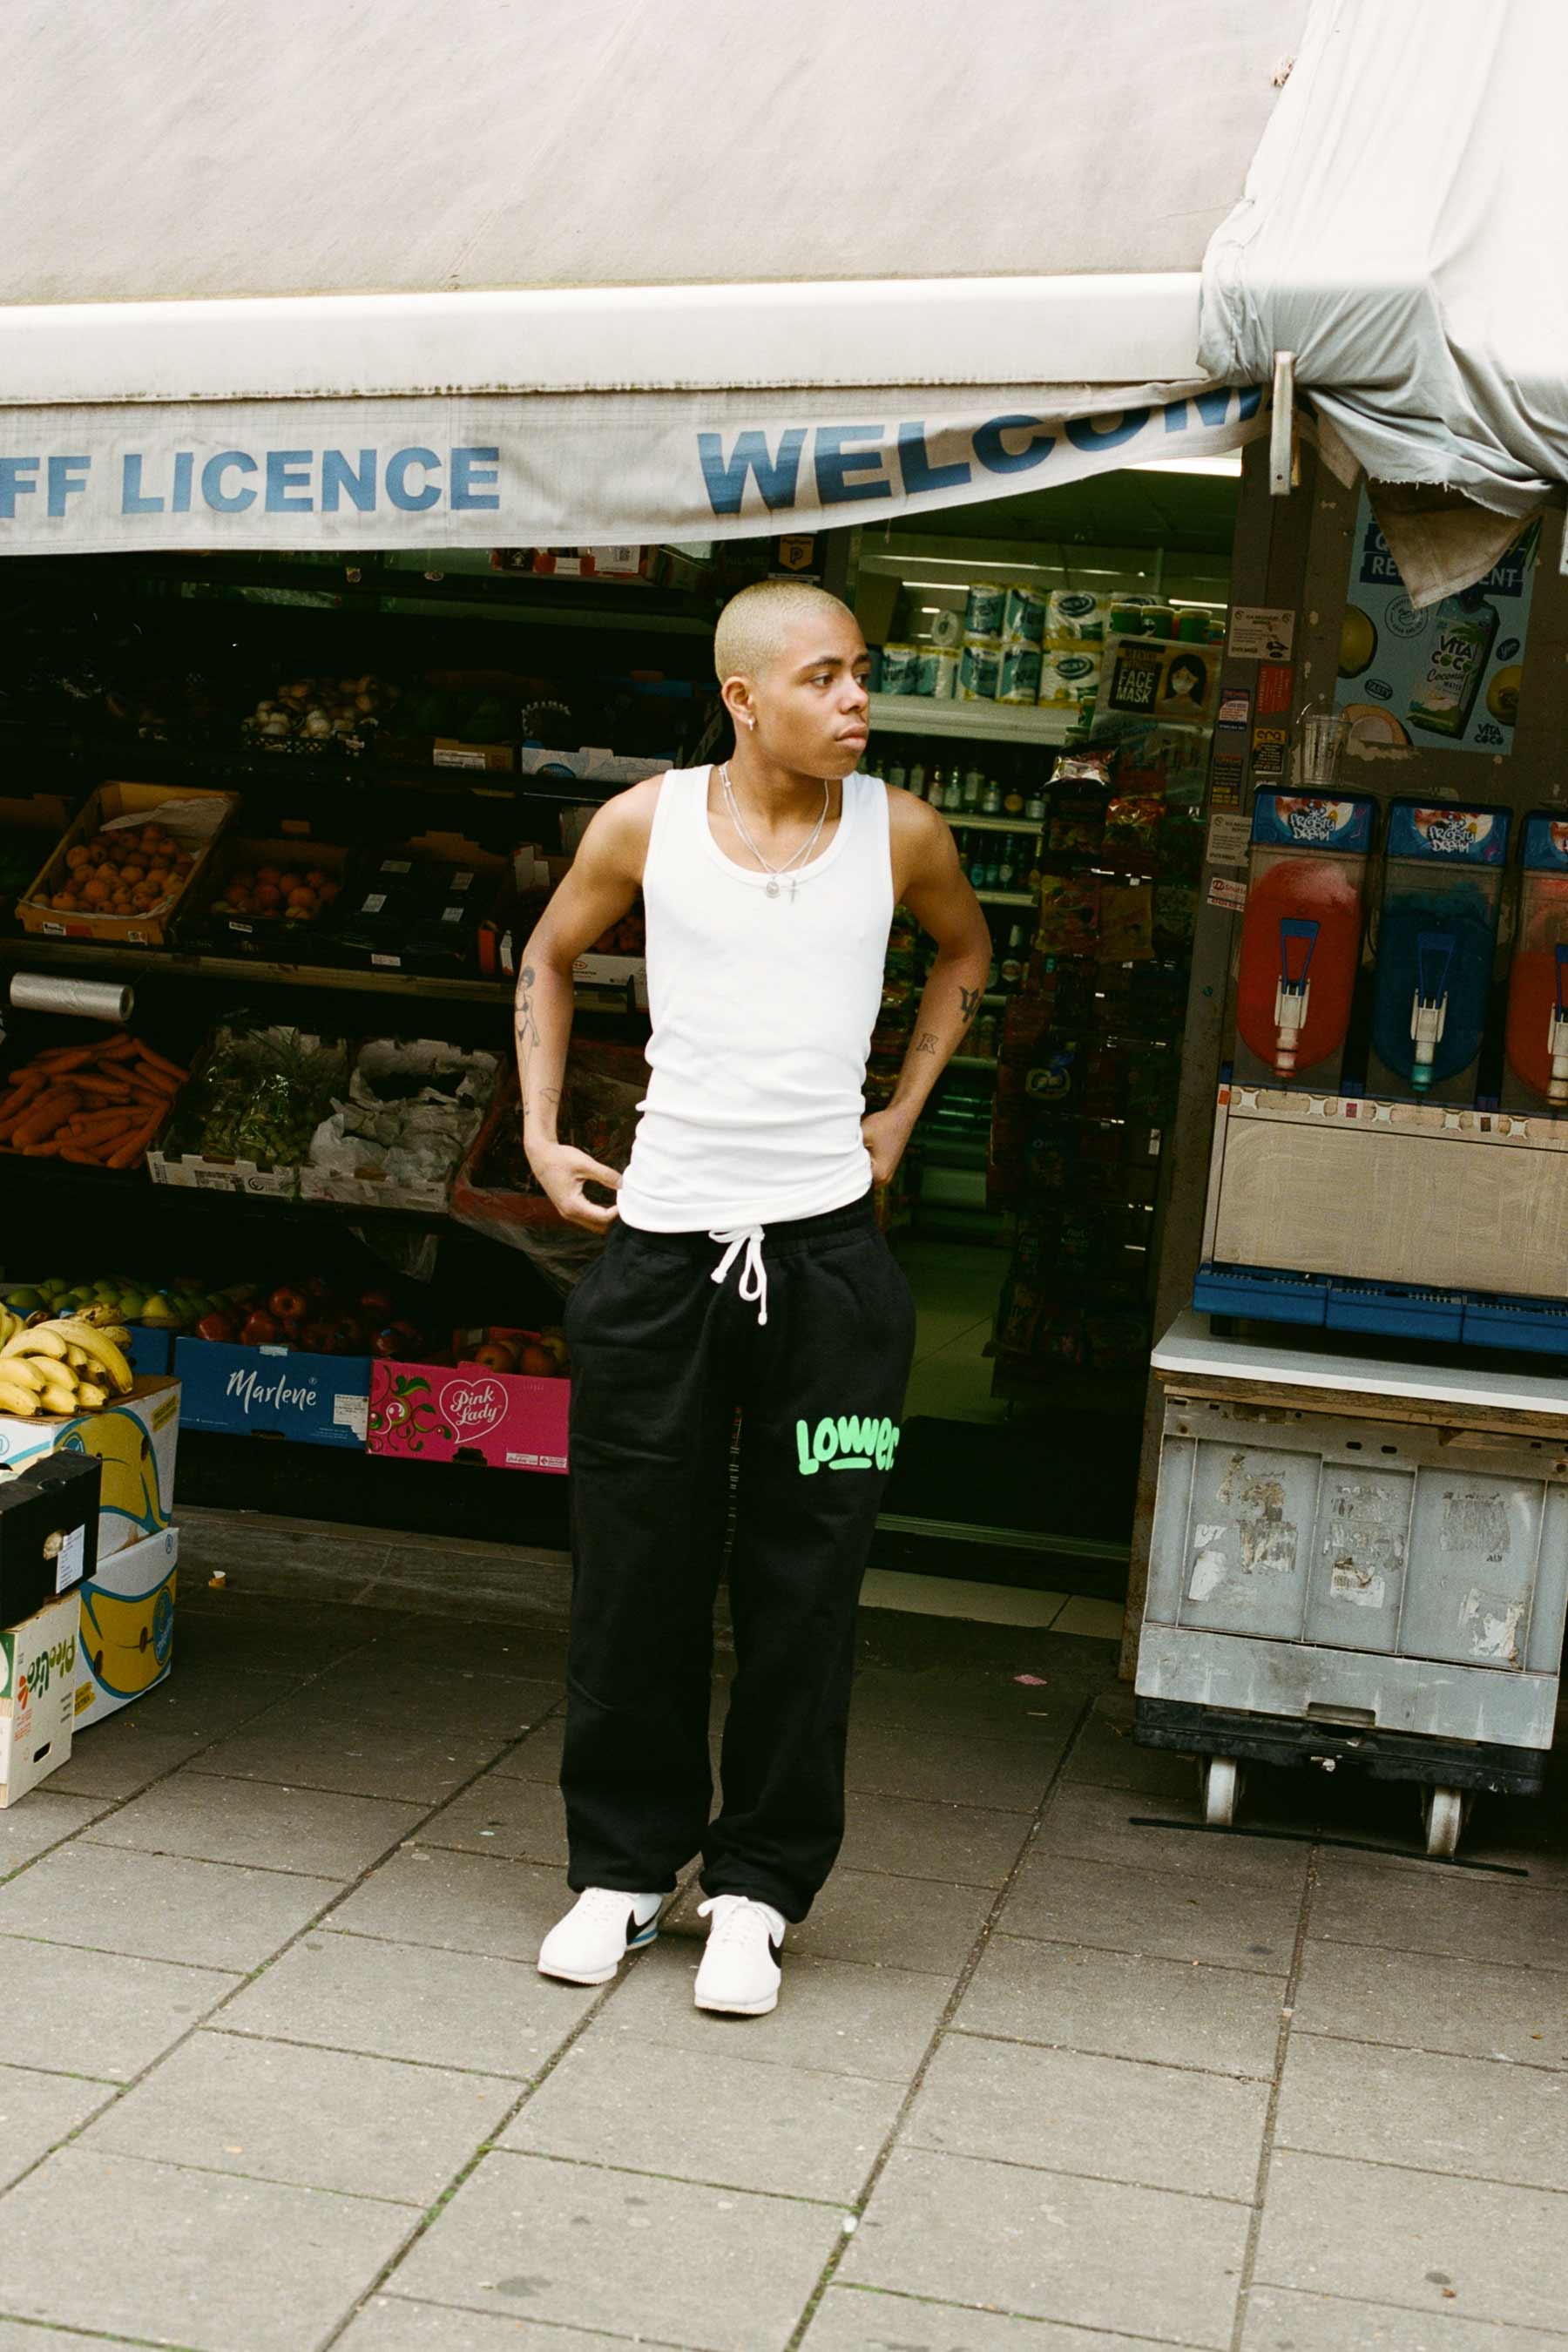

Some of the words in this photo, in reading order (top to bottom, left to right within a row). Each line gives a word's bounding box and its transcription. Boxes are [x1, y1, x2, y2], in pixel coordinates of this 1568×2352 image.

[122, 447, 499, 515] LICENCE
[1119, 668, 1155, 690] FACE
[1116, 686, 1152, 703] MASK
[1474, 733, 1504, 745] COCO
[1477, 723, 1502, 735] VITA
[226, 1369, 317, 1415] Marlene
[449, 1385, 494, 1413] Pink
[456, 1404, 497, 1426] Lady
